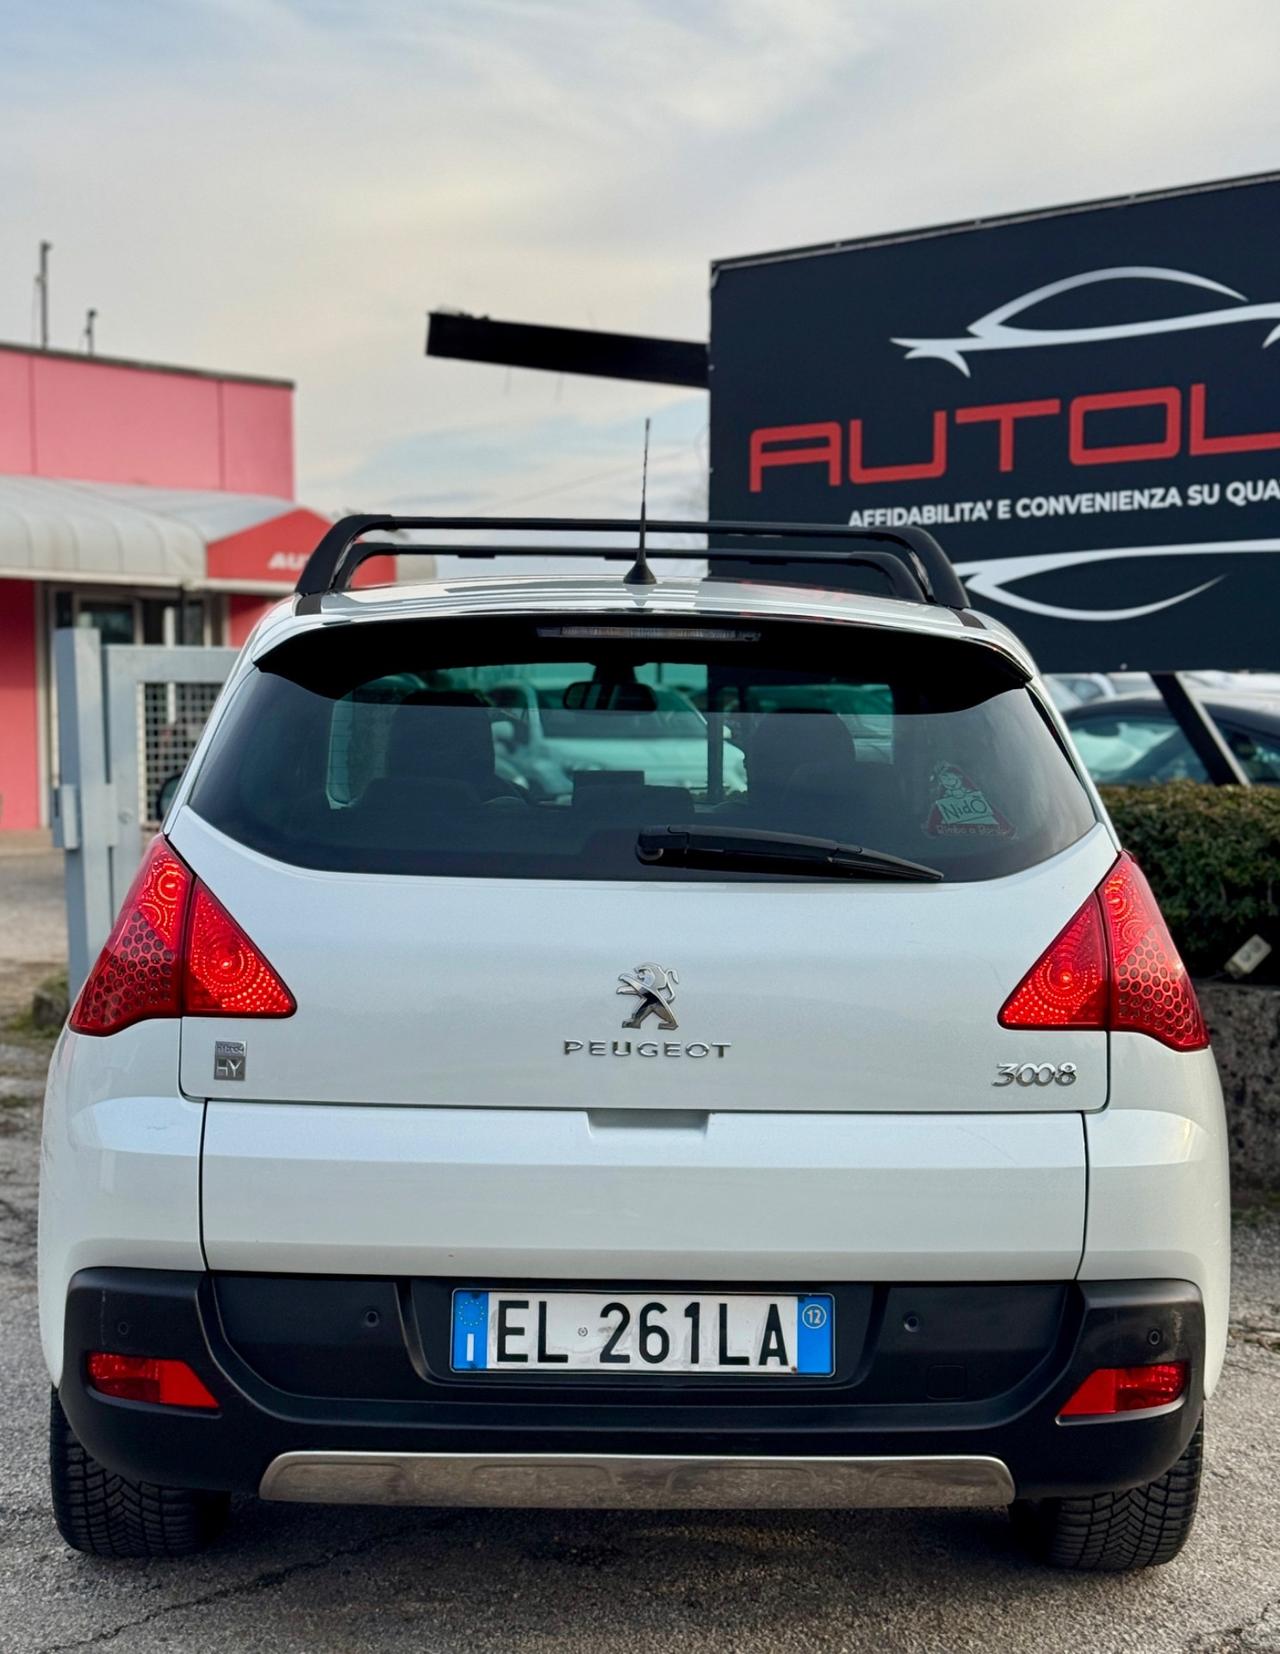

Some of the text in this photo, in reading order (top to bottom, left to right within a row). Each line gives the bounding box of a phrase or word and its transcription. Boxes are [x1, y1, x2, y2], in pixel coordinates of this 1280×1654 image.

[848, 479, 1280, 528] AFFIDABILITA' E CONVENIENZA SU QUA
[564, 1040, 732, 1058] PEUGEOT
[991, 1061, 1078, 1087] 3008
[807, 1308, 822, 1325] 12
[496, 1300, 789, 1366] EL 261LA
[466, 1333, 474, 1361] I
